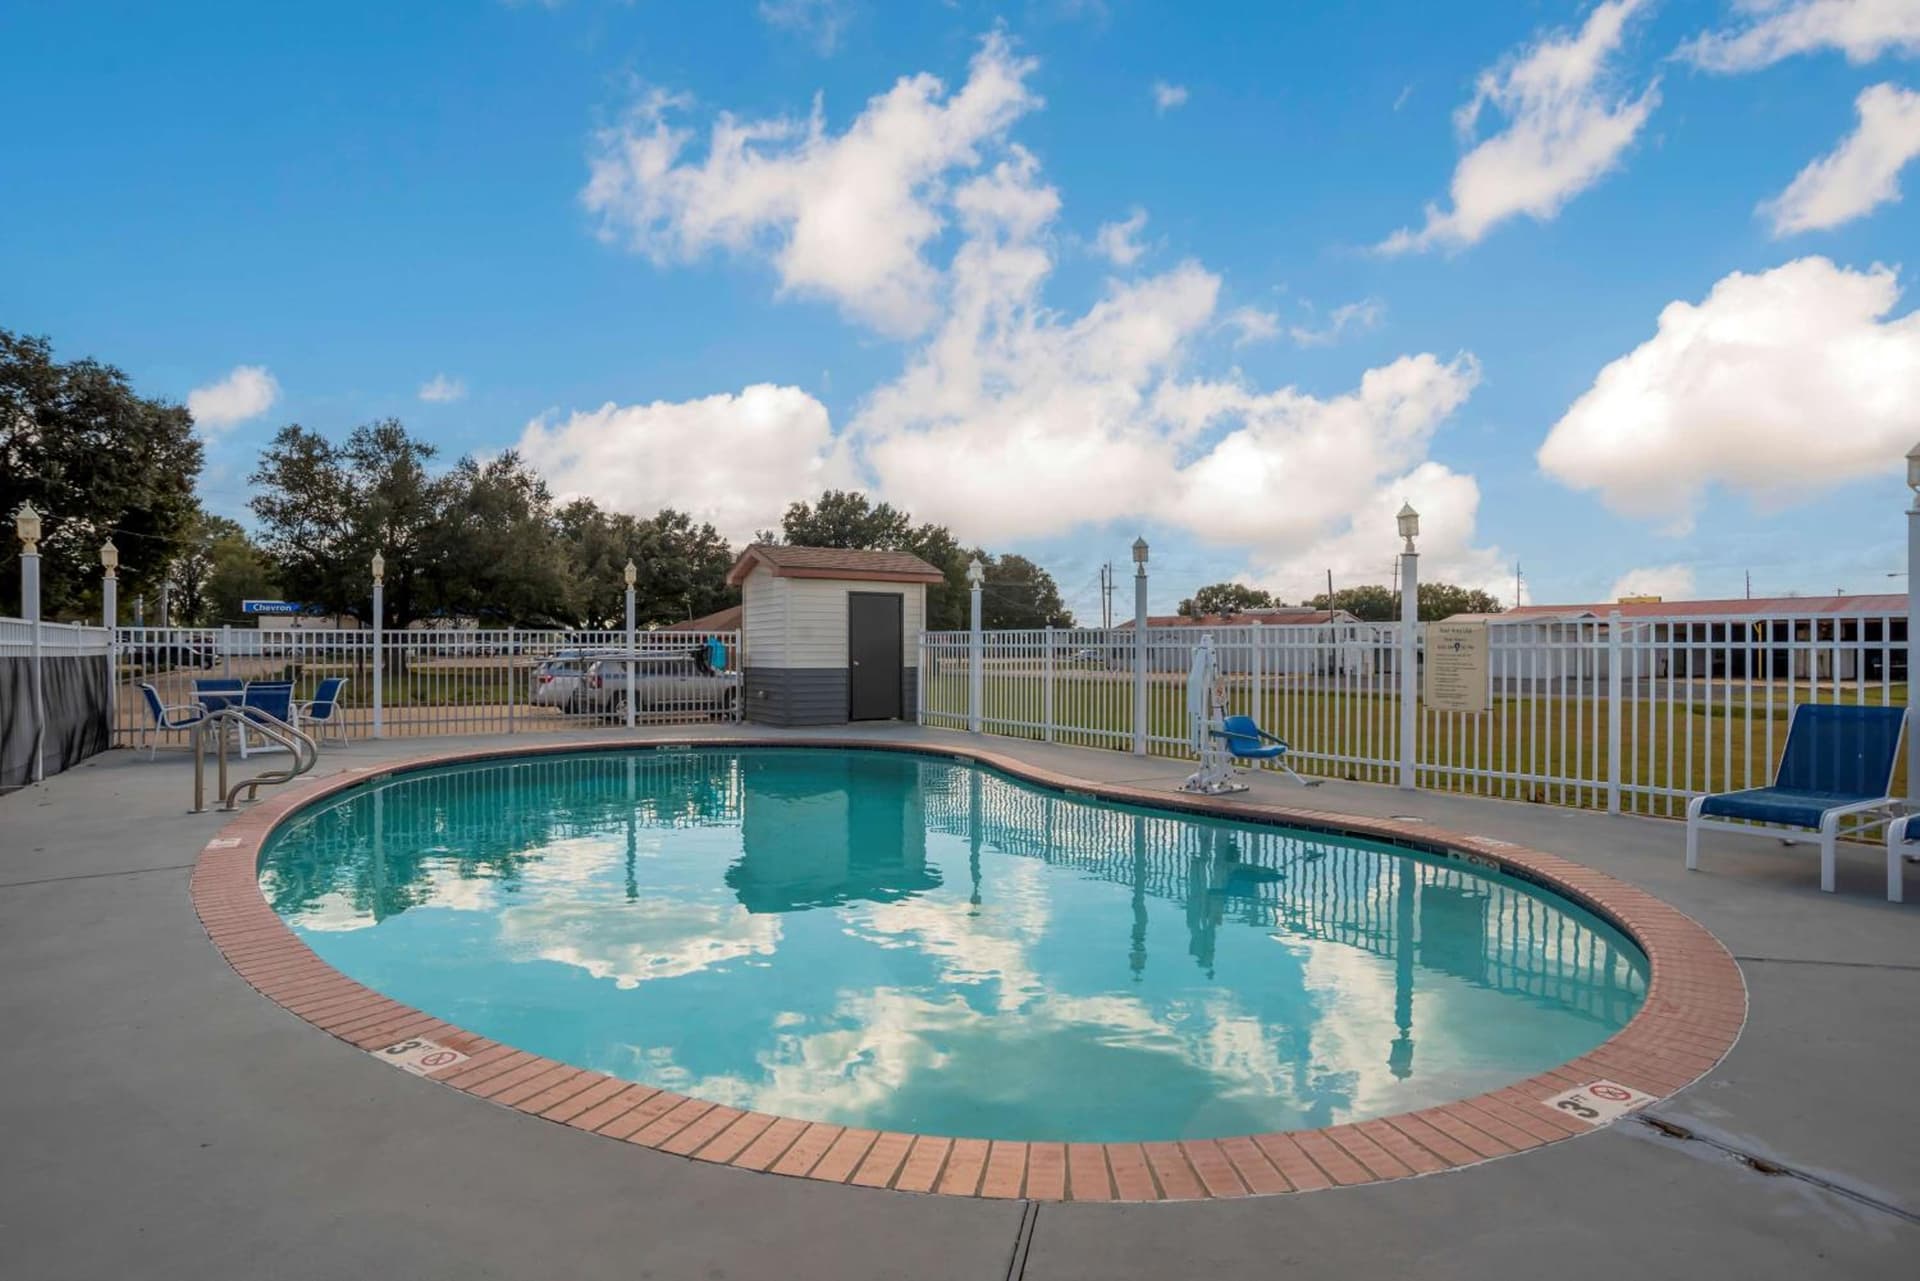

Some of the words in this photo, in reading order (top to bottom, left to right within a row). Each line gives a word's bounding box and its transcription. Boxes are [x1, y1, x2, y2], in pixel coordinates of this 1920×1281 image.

[252, 603, 292, 611] Chevron
[386, 1041, 422, 1054] 3
[1557, 1100, 1599, 1119] 3
